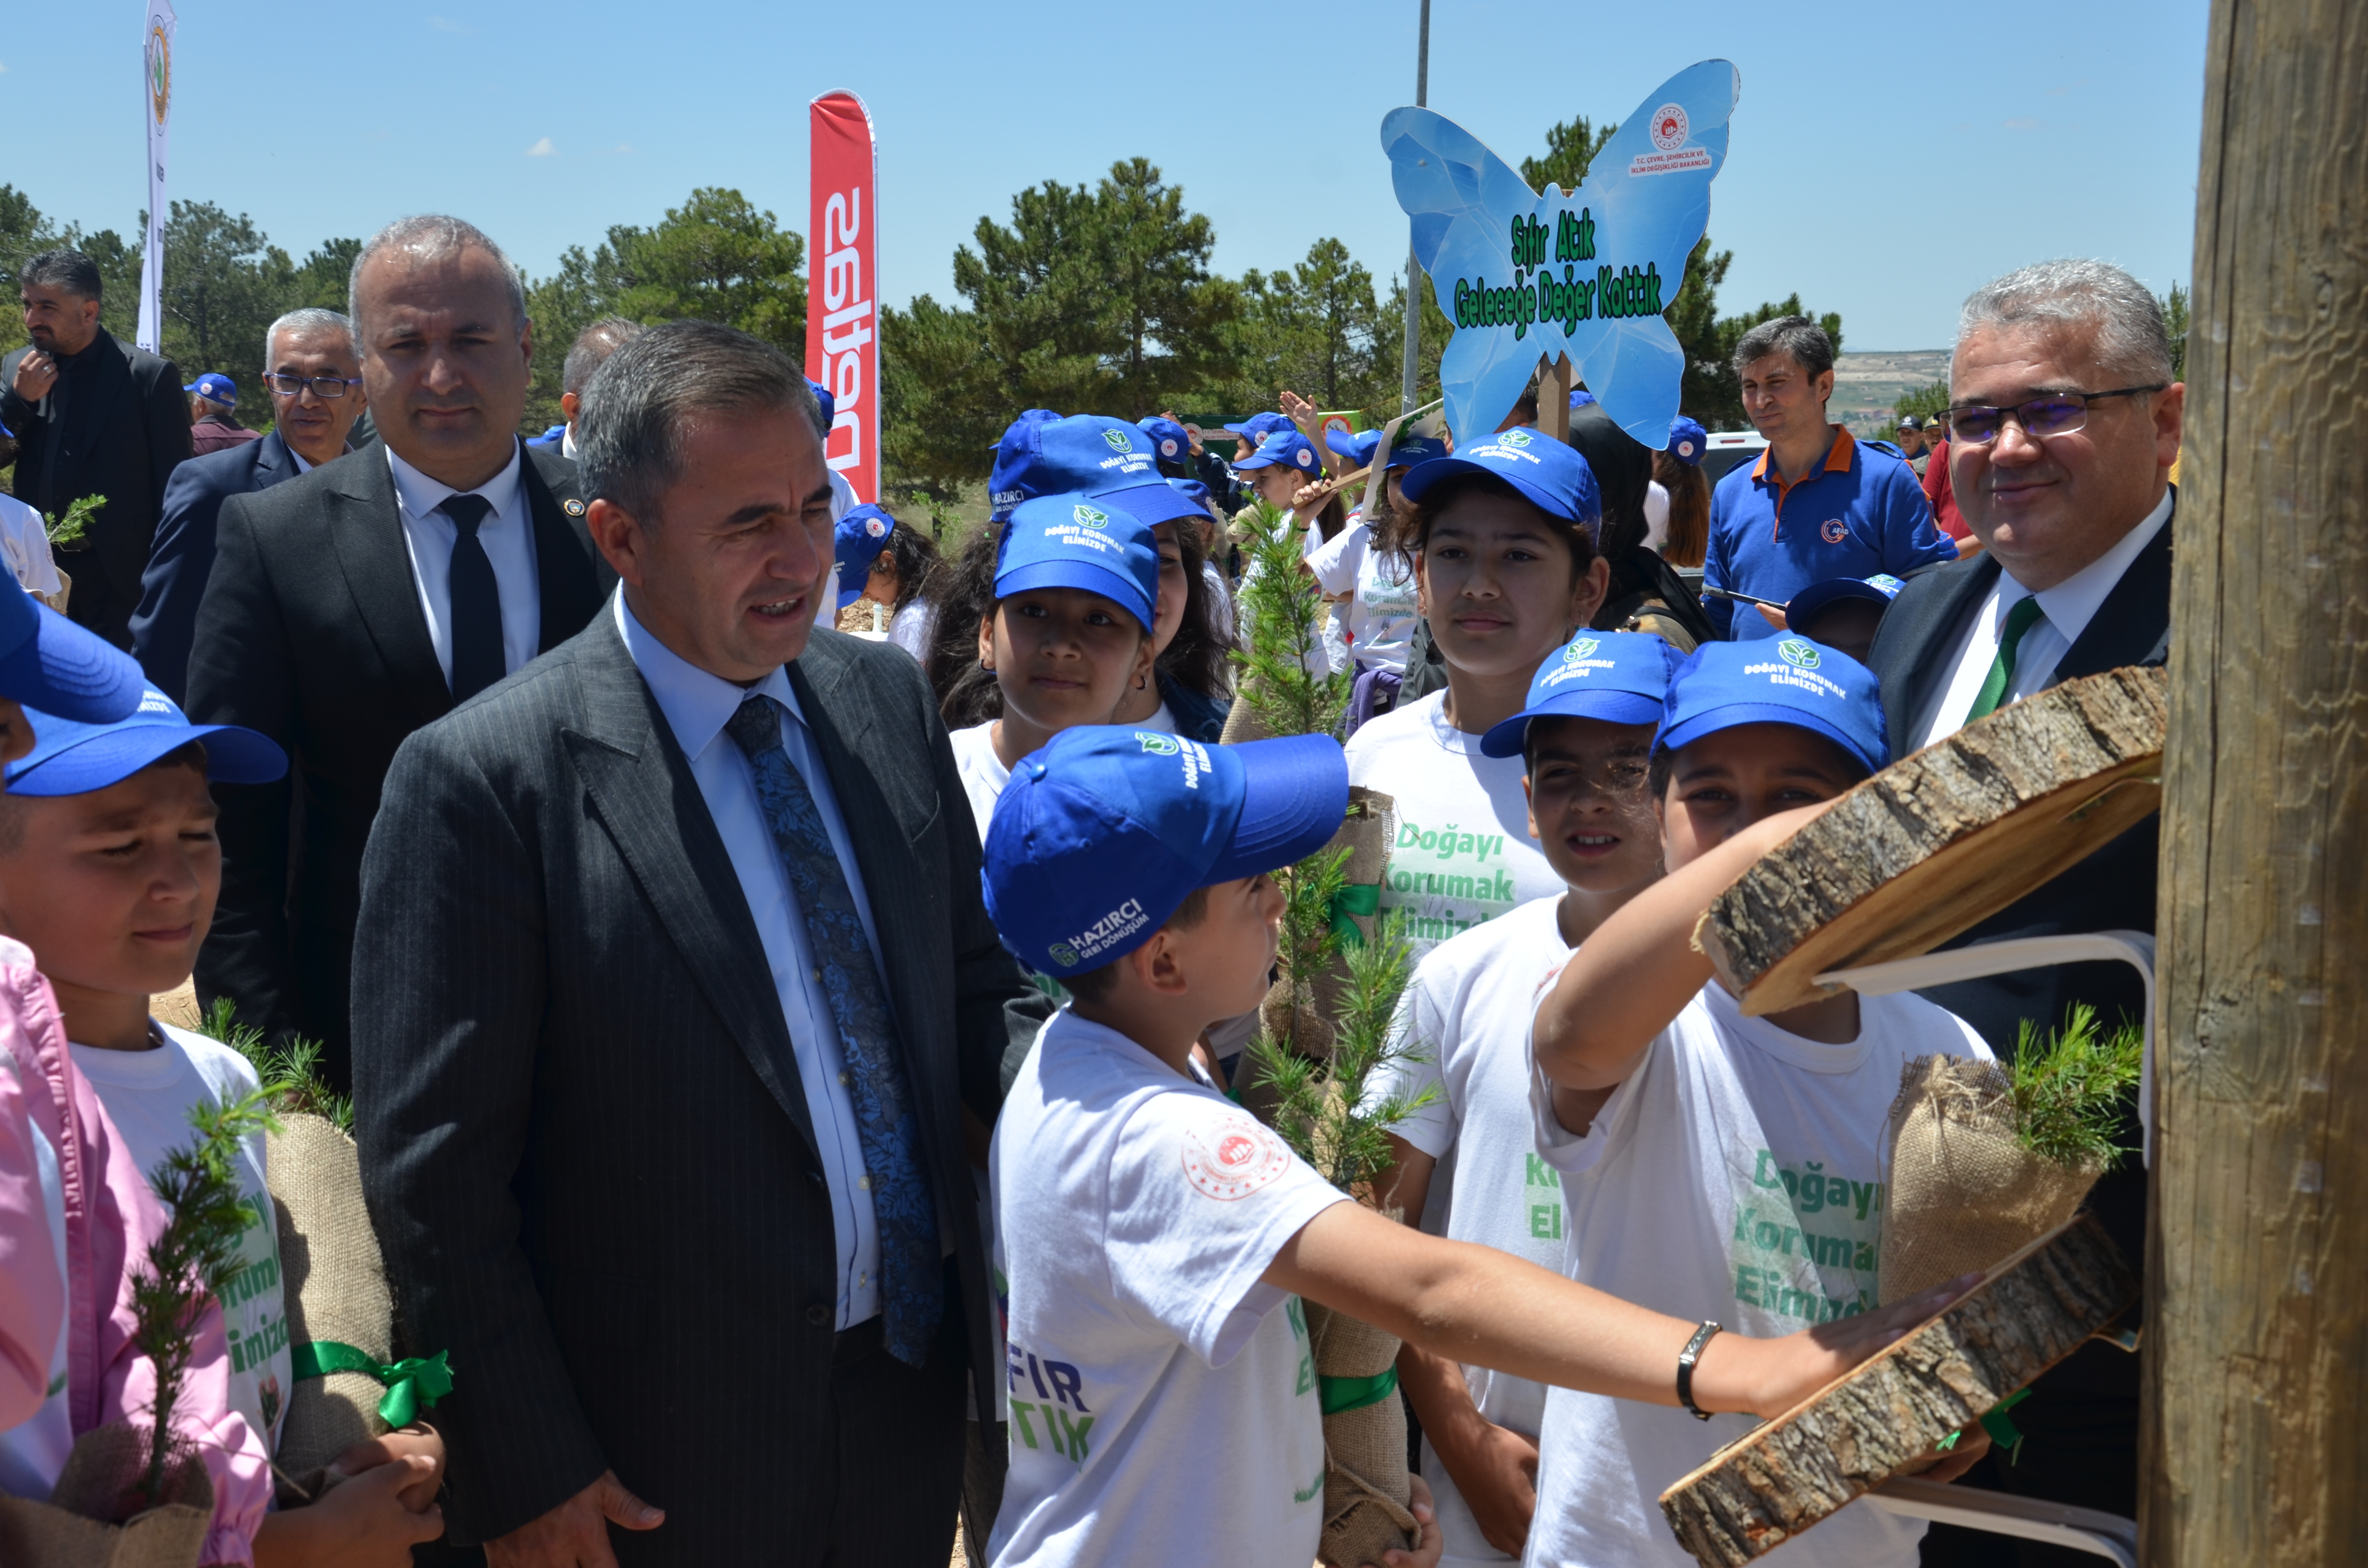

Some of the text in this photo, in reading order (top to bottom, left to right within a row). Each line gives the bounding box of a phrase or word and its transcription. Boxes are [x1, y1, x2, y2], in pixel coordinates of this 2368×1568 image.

[1647, 156, 1665, 164] ÇEVRE,
[1666, 151, 1695, 161] ŞEHİRCİLİK
[1647, 162, 1678, 172] DEĞİŞİKLİĞİ
[1679, 158, 1709, 168] BAKANLIĞI
[1511, 207, 1595, 276] Sıfır Atık
[1455, 261, 1662, 341] Geleceğe Değer Kattık
[1099, 457, 1127, 469] DOĞAYI
[1120, 461, 1149, 473] ELİMİZDE
[1499, 445, 1542, 465] KORUMAK
[995, 490, 1024, 504] HAZIRCI
[1045, 524, 1125, 554] DOĞAYI KORUMAK
[1062, 534, 1107, 552] ELİMİZDE
[1567, 659, 1616, 671] KORUMAK
[1744, 662, 1846, 699] DOĞAYI KORUMAK
[1770, 674, 1825, 697] ELİMİZDE
[1181, 752, 1198, 789] DOĞAYI
[1395, 822, 1504, 862] Doğayı
[1068, 898, 1142, 950] HAZIRCI
[1081, 913, 1150, 959] GERİ DÖNÜŞÜM
[1754, 1149, 1885, 1221] Doğayı
[1008, 1396, 1095, 1471] TIK
